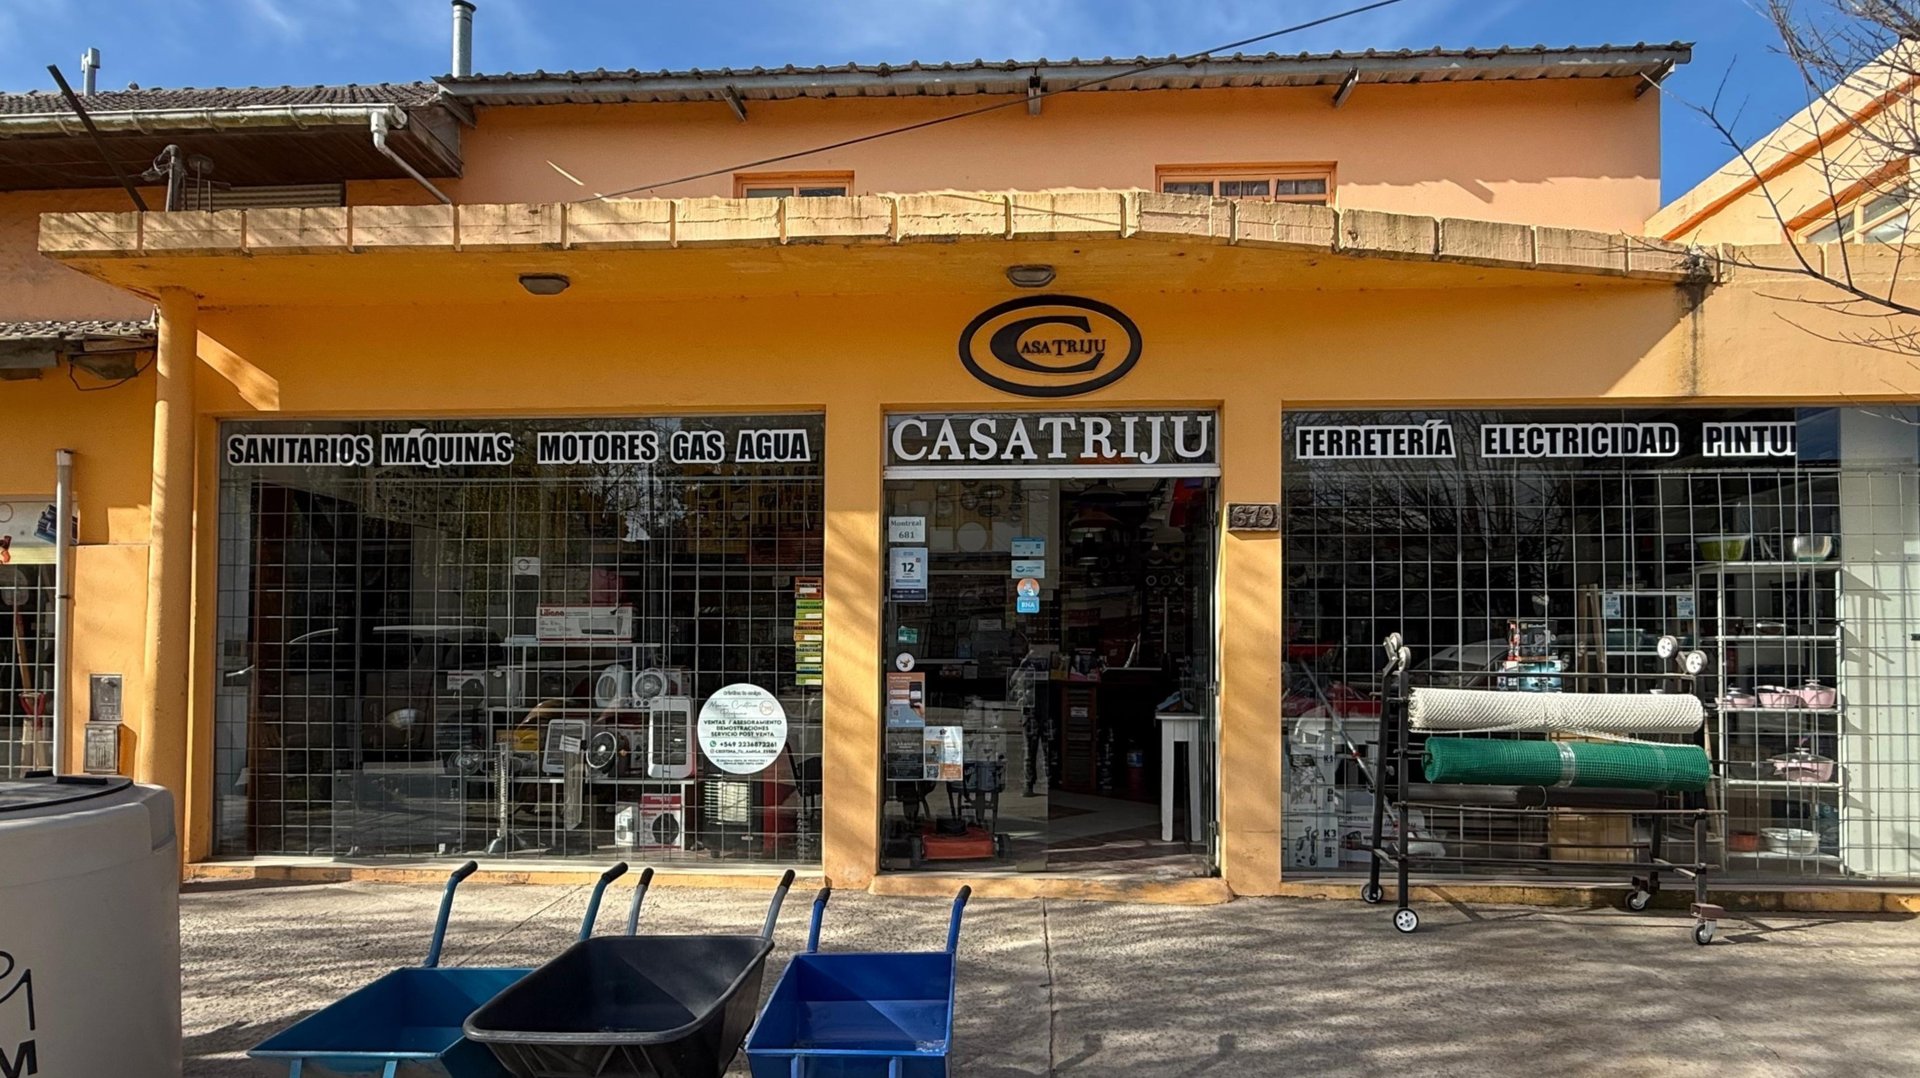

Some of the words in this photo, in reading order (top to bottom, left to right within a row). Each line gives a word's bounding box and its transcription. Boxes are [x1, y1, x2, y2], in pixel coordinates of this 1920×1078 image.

[892, 415, 1212, 464] CASATRIJU
[1297, 420, 1456, 458] FERRETERÍA
[1482, 423, 1679, 457] ELECTRICIDAD
[229, 435, 373, 465] SANITARIOS
[382, 429, 514, 467] MÁQUINAS
[538, 432, 658, 464] MOTORES
[670, 430, 725, 463] GAS
[736, 429, 810, 462] AGUA
[890, 519, 922, 527] Montreal
[1232, 505, 1274, 526] 679
[898, 530, 915, 539] 681
[901, 562, 915, 573] 12
[1323, 828, 1337, 838] K3
